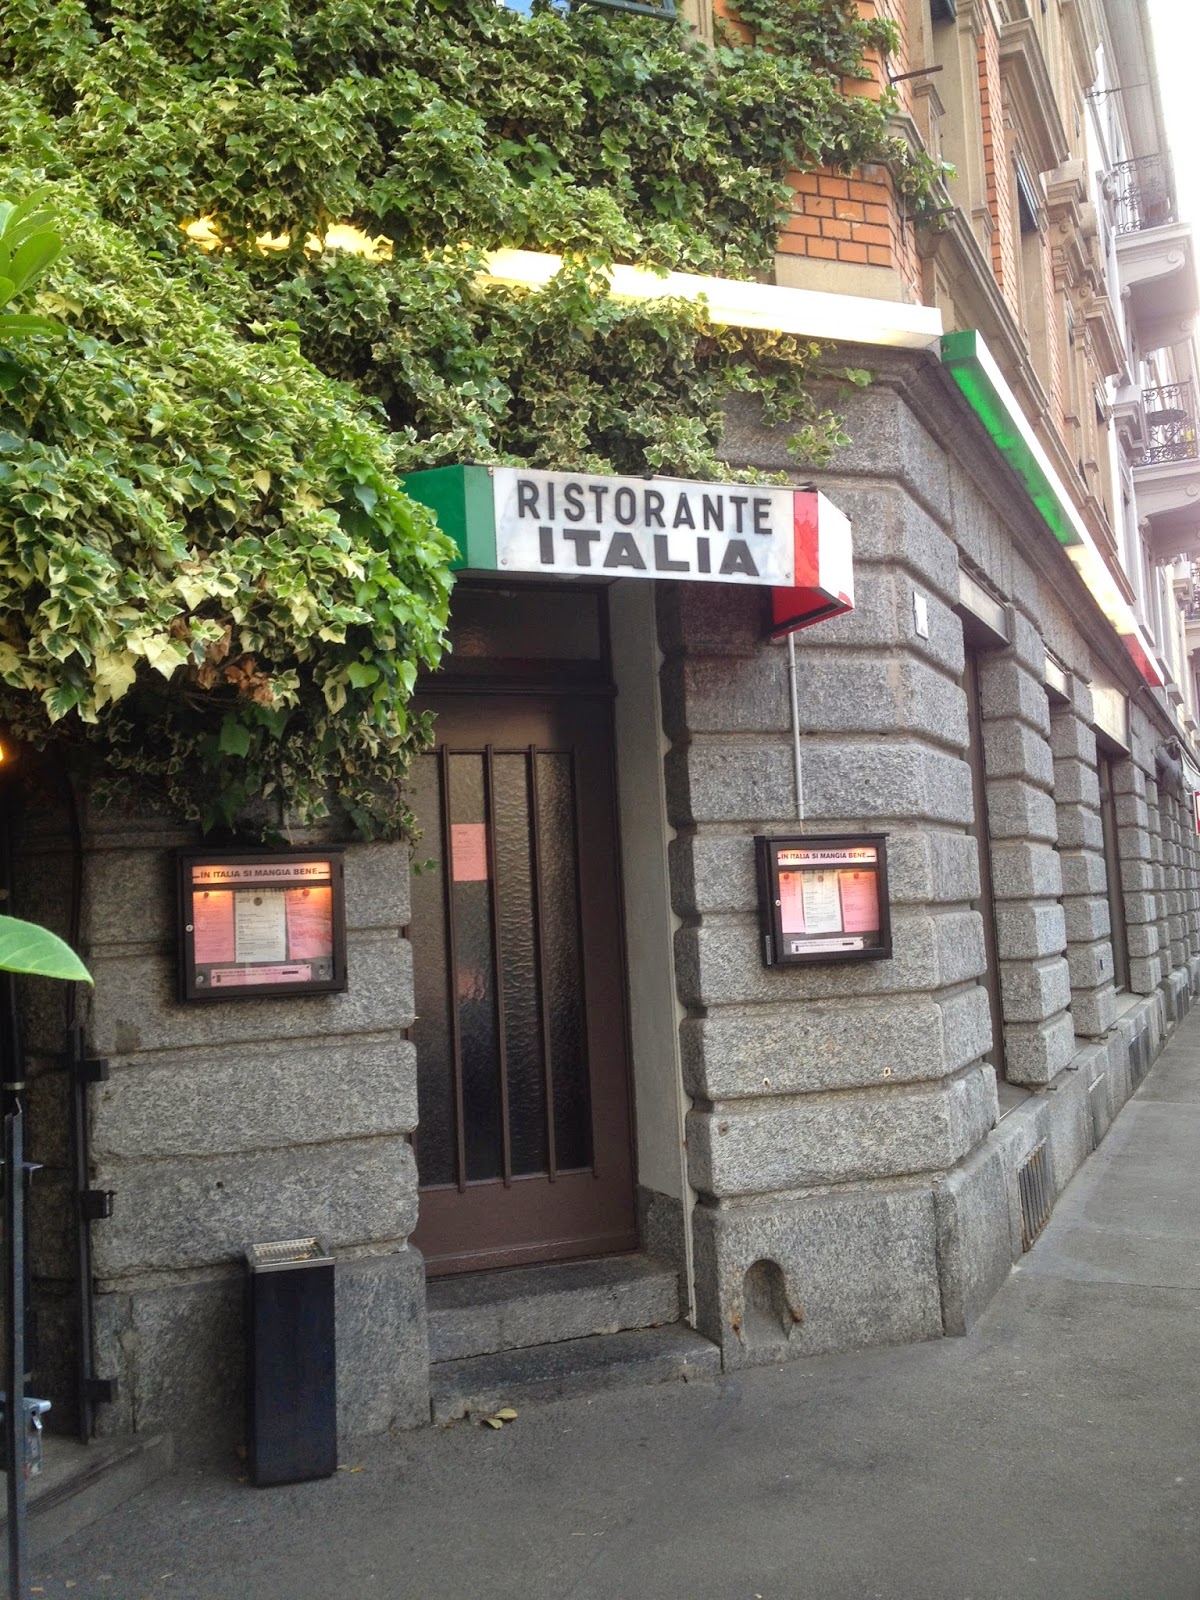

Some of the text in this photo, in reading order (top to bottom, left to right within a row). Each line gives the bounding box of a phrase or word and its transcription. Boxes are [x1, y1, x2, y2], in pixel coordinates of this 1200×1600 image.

[517, 479, 773, 535] RISTORANTE
[538, 526, 760, 577] ITALIA
[200, 871, 211, 879] IN
[213, 870, 241, 878] ITALIA
[255, 868, 292, 877] MANGIA
[293, 867, 318, 875] BENE
